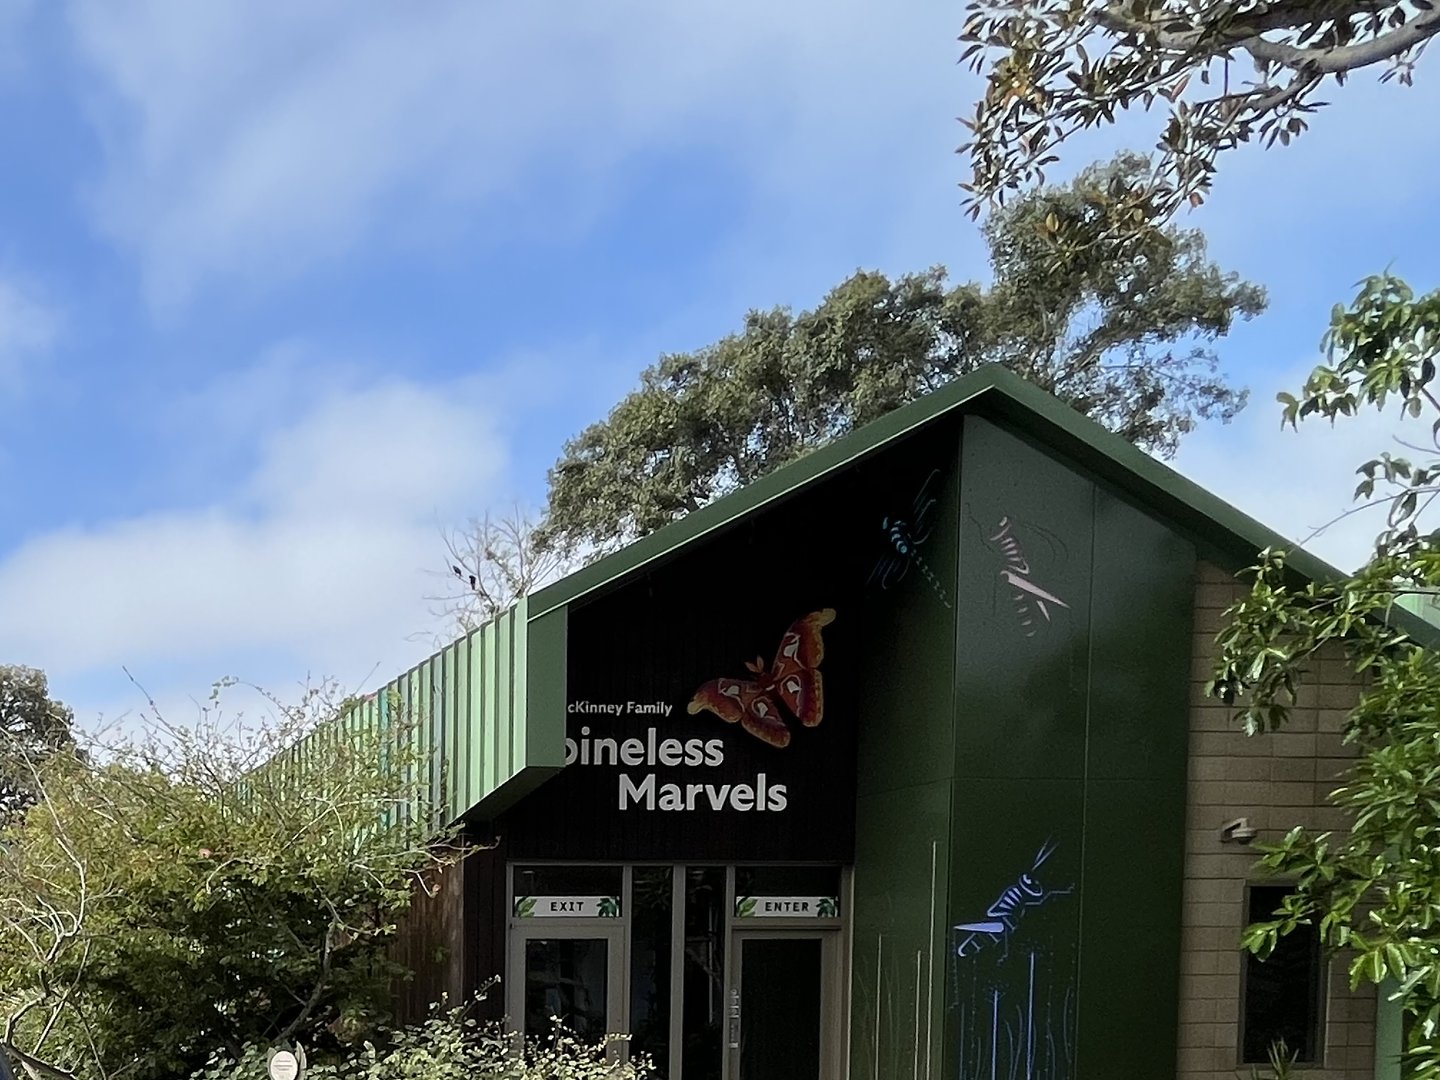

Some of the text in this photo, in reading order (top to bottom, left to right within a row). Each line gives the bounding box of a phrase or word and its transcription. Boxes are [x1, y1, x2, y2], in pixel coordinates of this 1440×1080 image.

[626, 701, 673, 717] Family
[618, 773, 788, 812] Marvels
[550, 901, 585, 912] EXIT
[764, 901, 809, 912] ENTER
